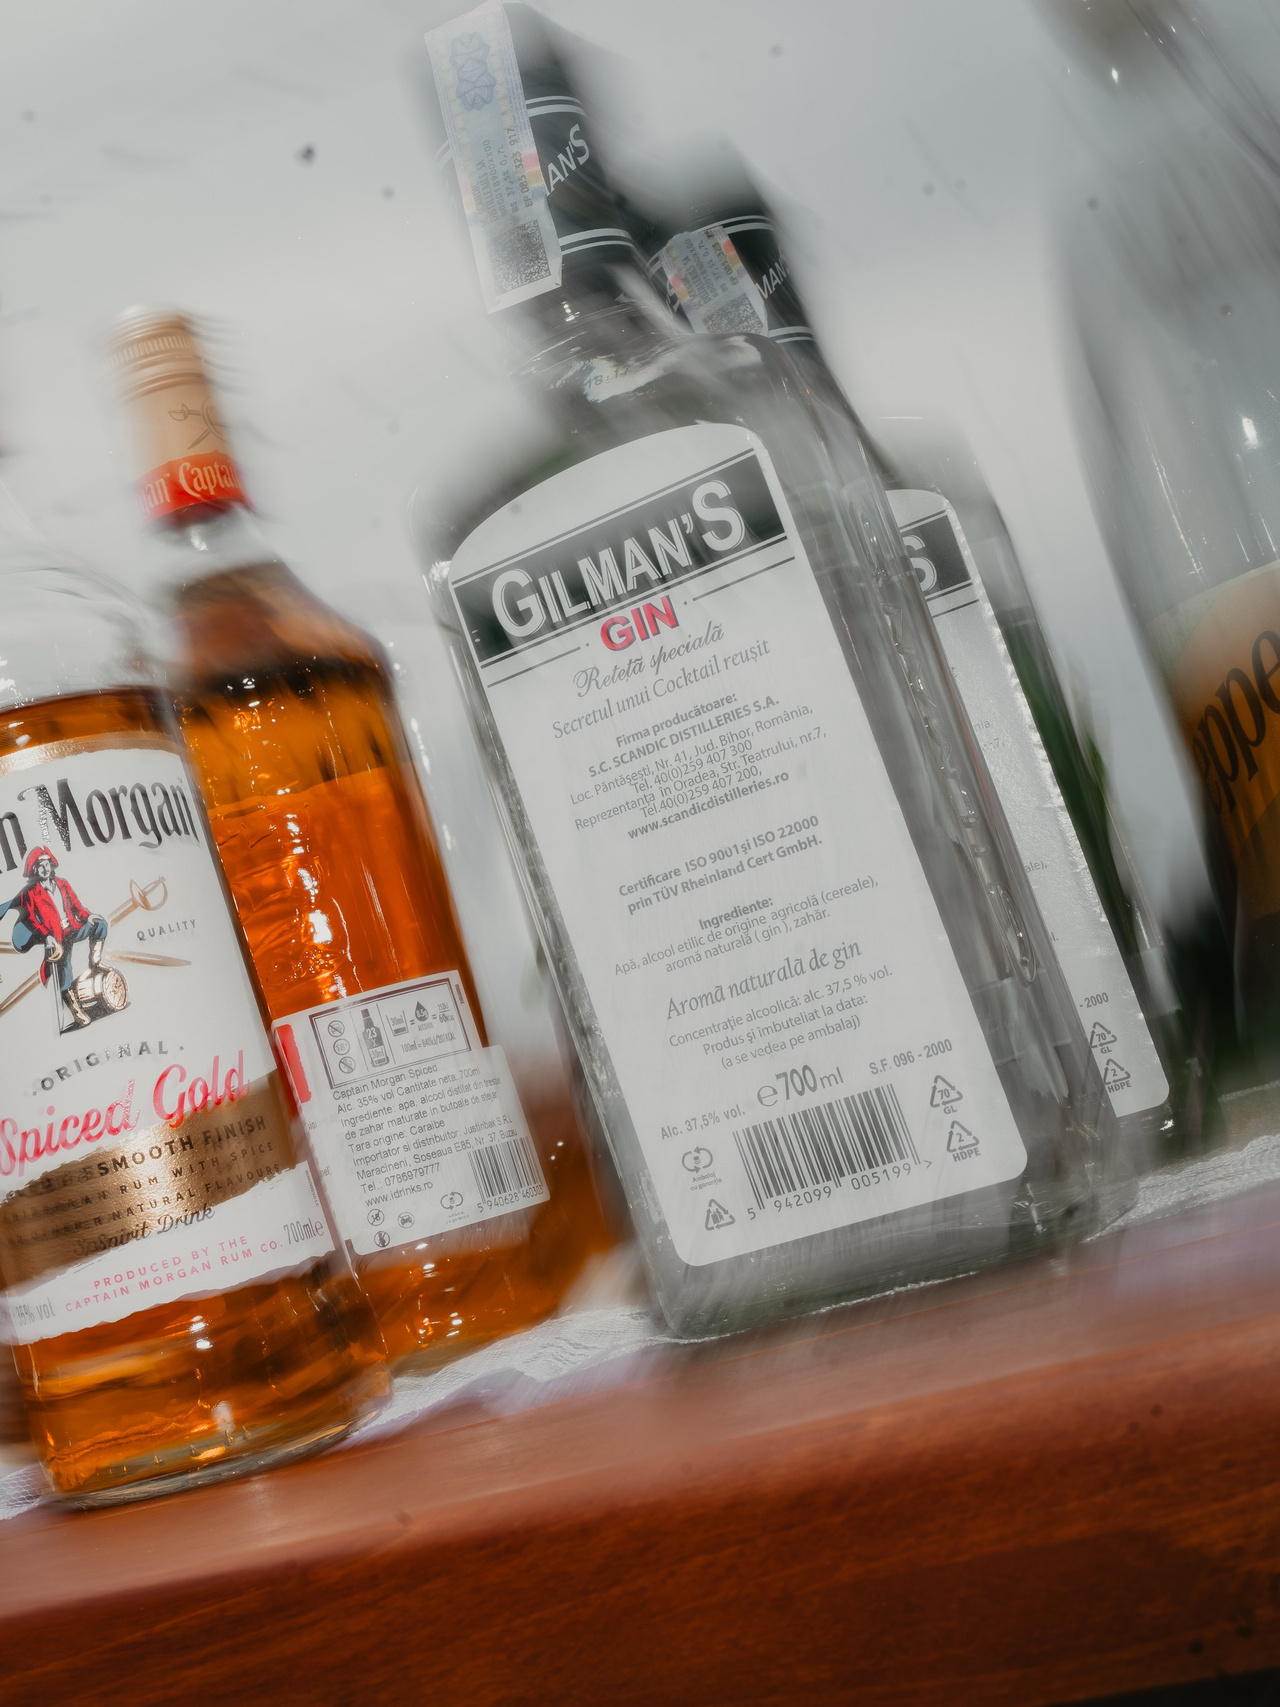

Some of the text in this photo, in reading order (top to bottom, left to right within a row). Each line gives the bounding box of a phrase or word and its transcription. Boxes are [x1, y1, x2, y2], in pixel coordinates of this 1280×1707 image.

[506, 126, 533, 207] EP 085 323 917
[544, 125, 590, 195] AN'S
[476, 159, 498, 221] DISTILLERIES SA
[491, 480, 745, 639] GILMAN'S
[600, 596, 680, 652] GIN
[553, 655, 720, 738] Secretul unui Cocktail
[588, 695, 779, 777] S.C. SCANDIC DISTILLERIES S.A.
[616, 694, 736, 747] Firma producătoare:
[570, 704, 812, 805] Loc. Nr. 41, Jud. Bihor, România,
[632, 739, 752, 793] Tel. 40(0)259 407 300
[672, 737, 797, 792] Oradea, Str. Teatrului,
[712, 765, 762, 791] 407 200,
[17, 777, 198, 850] Morgan
[629, 773, 788, 838] www.scandicdistilleries.ro
[619, 815, 818, 896] Certificare ISO ISO 22000
[628, 835, 822, 915] prin TÜV Rheinland Cert GmbH.
[137, 917, 195, 941] QUALITY
[642, 875, 878, 965] alcool etilic de origine agricolă (cereale),
[699, 898, 773, 929] Ingrediente:
[704, 932, 752, 958] naturală
[806, 939, 862, 971] de gin
[803, 964, 892, 1003] alc. 37,5 % vol.
[1084, 992, 1109, 1008] 2000
[366, 1027, 377, 1039] 23
[390, 1014, 404, 1026] 30ml
[703, 994, 867, 1055] Produs la data:
[735, 1015, 860, 1064] se vedea pe ambalaj)
[1095, 1032, 1106, 1042] 70
[41, 1039, 169, 1092] ORIGINAL
[869, 1039, 952, 1075] S.F. 096 2000
[1100, 1046, 1112, 1054] GL
[151, 1050, 248, 1129] Gold
[332, 1063, 438, 1100] Captain Morgan Spiced
[337, 1101, 354, 1114] Alc.
[357, 1094, 378, 1107] 35%
[380, 1089, 394, 1100] vol
[396, 1079, 436, 1095] Cantitate
[776, 1065, 844, 1100] 700 ml
[937, 1088, 950, 1100] 70
[1107, 1080, 1131, 1093] HDPE
[341, 1083, 472, 1127] Ingrediente: apa, alcool distilat
[344, 1107, 439, 1140] de zahar maturate in
[661, 1104, 745, 1140] Alc. 37,5% vol.
[943, 1105, 957, 1114] GL
[95, 1115, 266, 1176] SMOOTH FINISH
[348, 1119, 445, 1153] Tara origine: Caraibe
[353, 1129, 461, 1166] Importator si distribuitor:
[952, 1147, 980, 1162] HDPE
[956, 1132, 964, 1143] 2
[119, 1141, 274, 1195] RUM WITH SPICE
[356, 1139, 474, 1180] Maracineni, Soseaua E85,
[384, 1162, 439, 1186] 0786979777
[365, 1182, 433, 1206] www.idrinks.ro
[486, 1191, 519, 1209] 940628
[747, 1163, 911, 1220] 5 942099 005199
[65, 1239, 283, 1312] CAPTAIN MORGAN RUM CO.
[94, 1236, 247, 1289] PRODUCED BY THE
